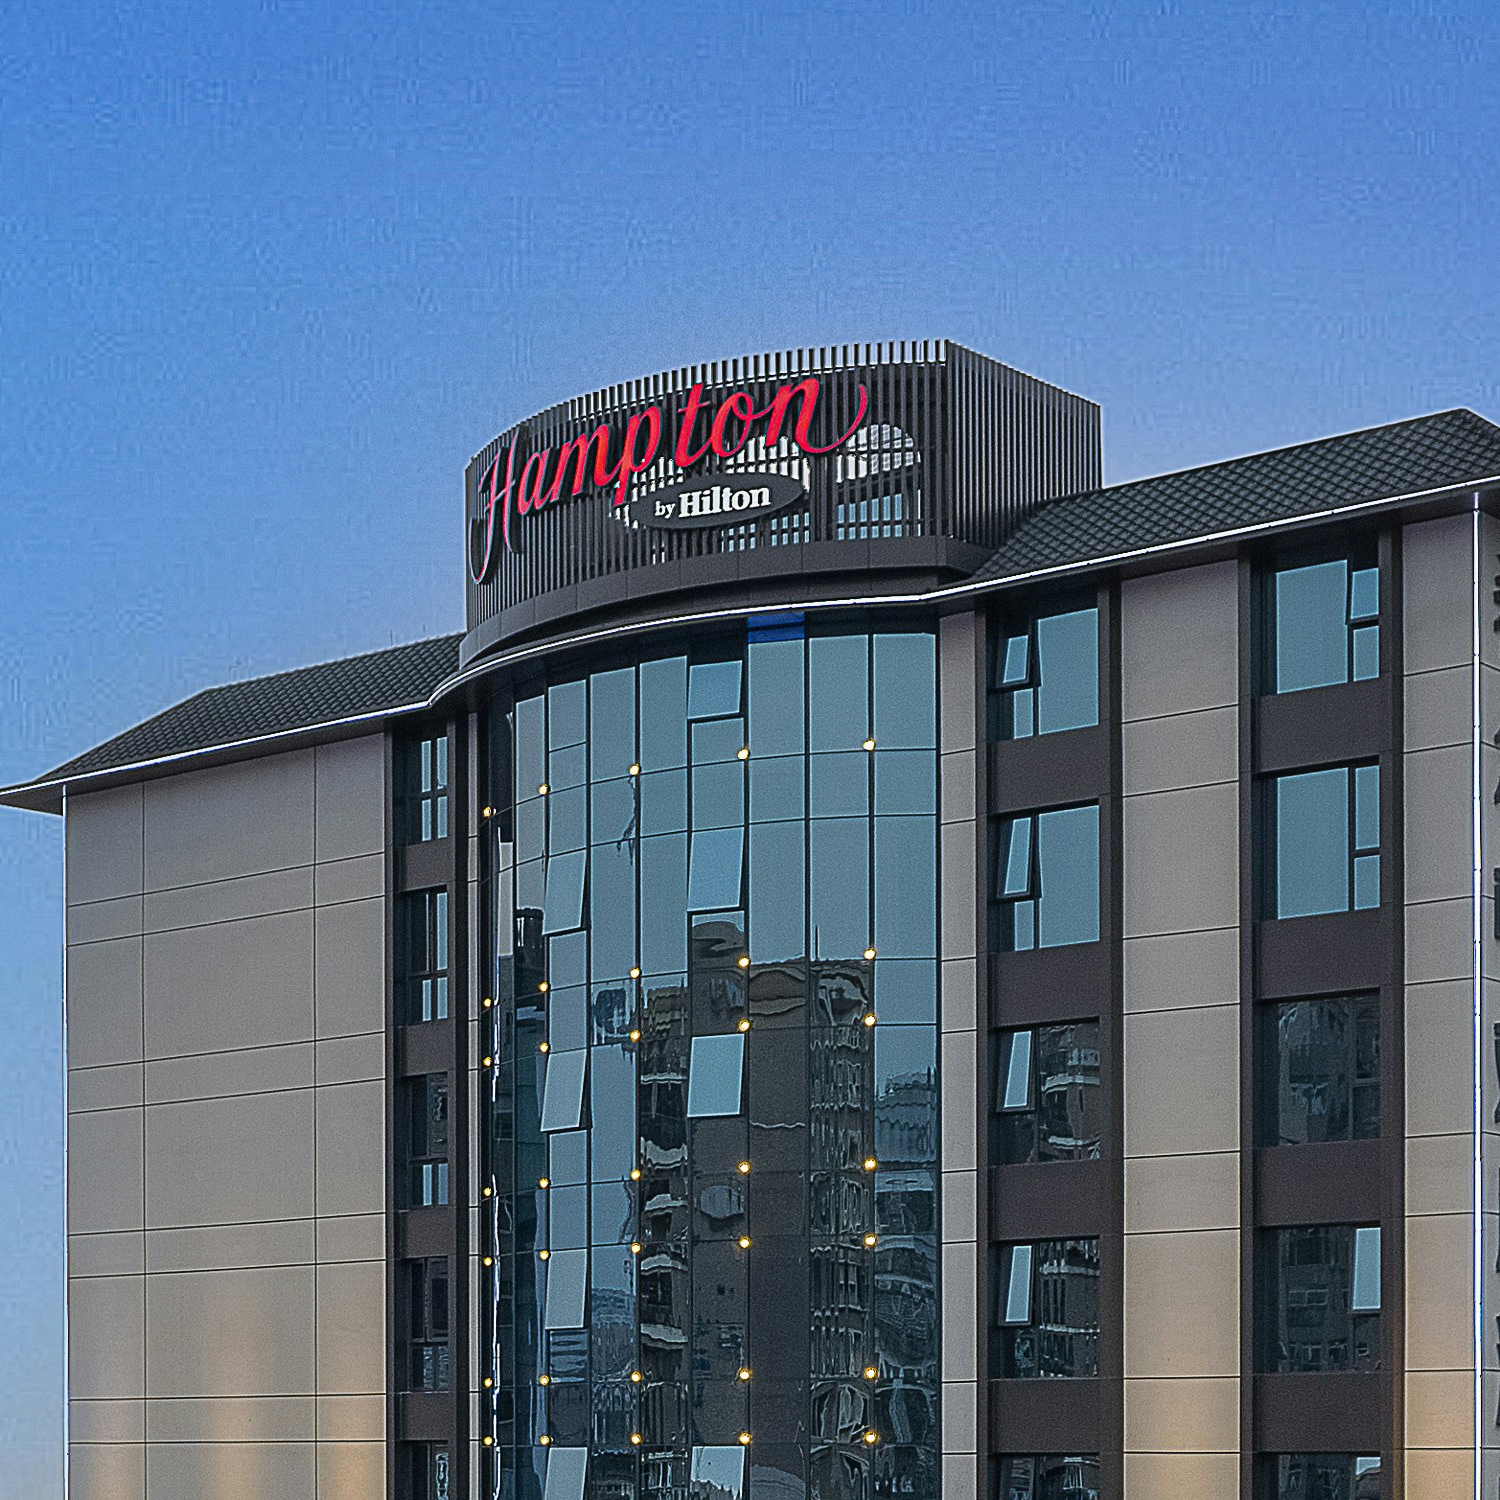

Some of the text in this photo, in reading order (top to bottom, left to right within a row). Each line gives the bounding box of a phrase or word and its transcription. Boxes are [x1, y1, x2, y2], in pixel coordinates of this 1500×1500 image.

[468, 377, 868, 585] Hampton
[654, 485, 771, 519] by Hilton
